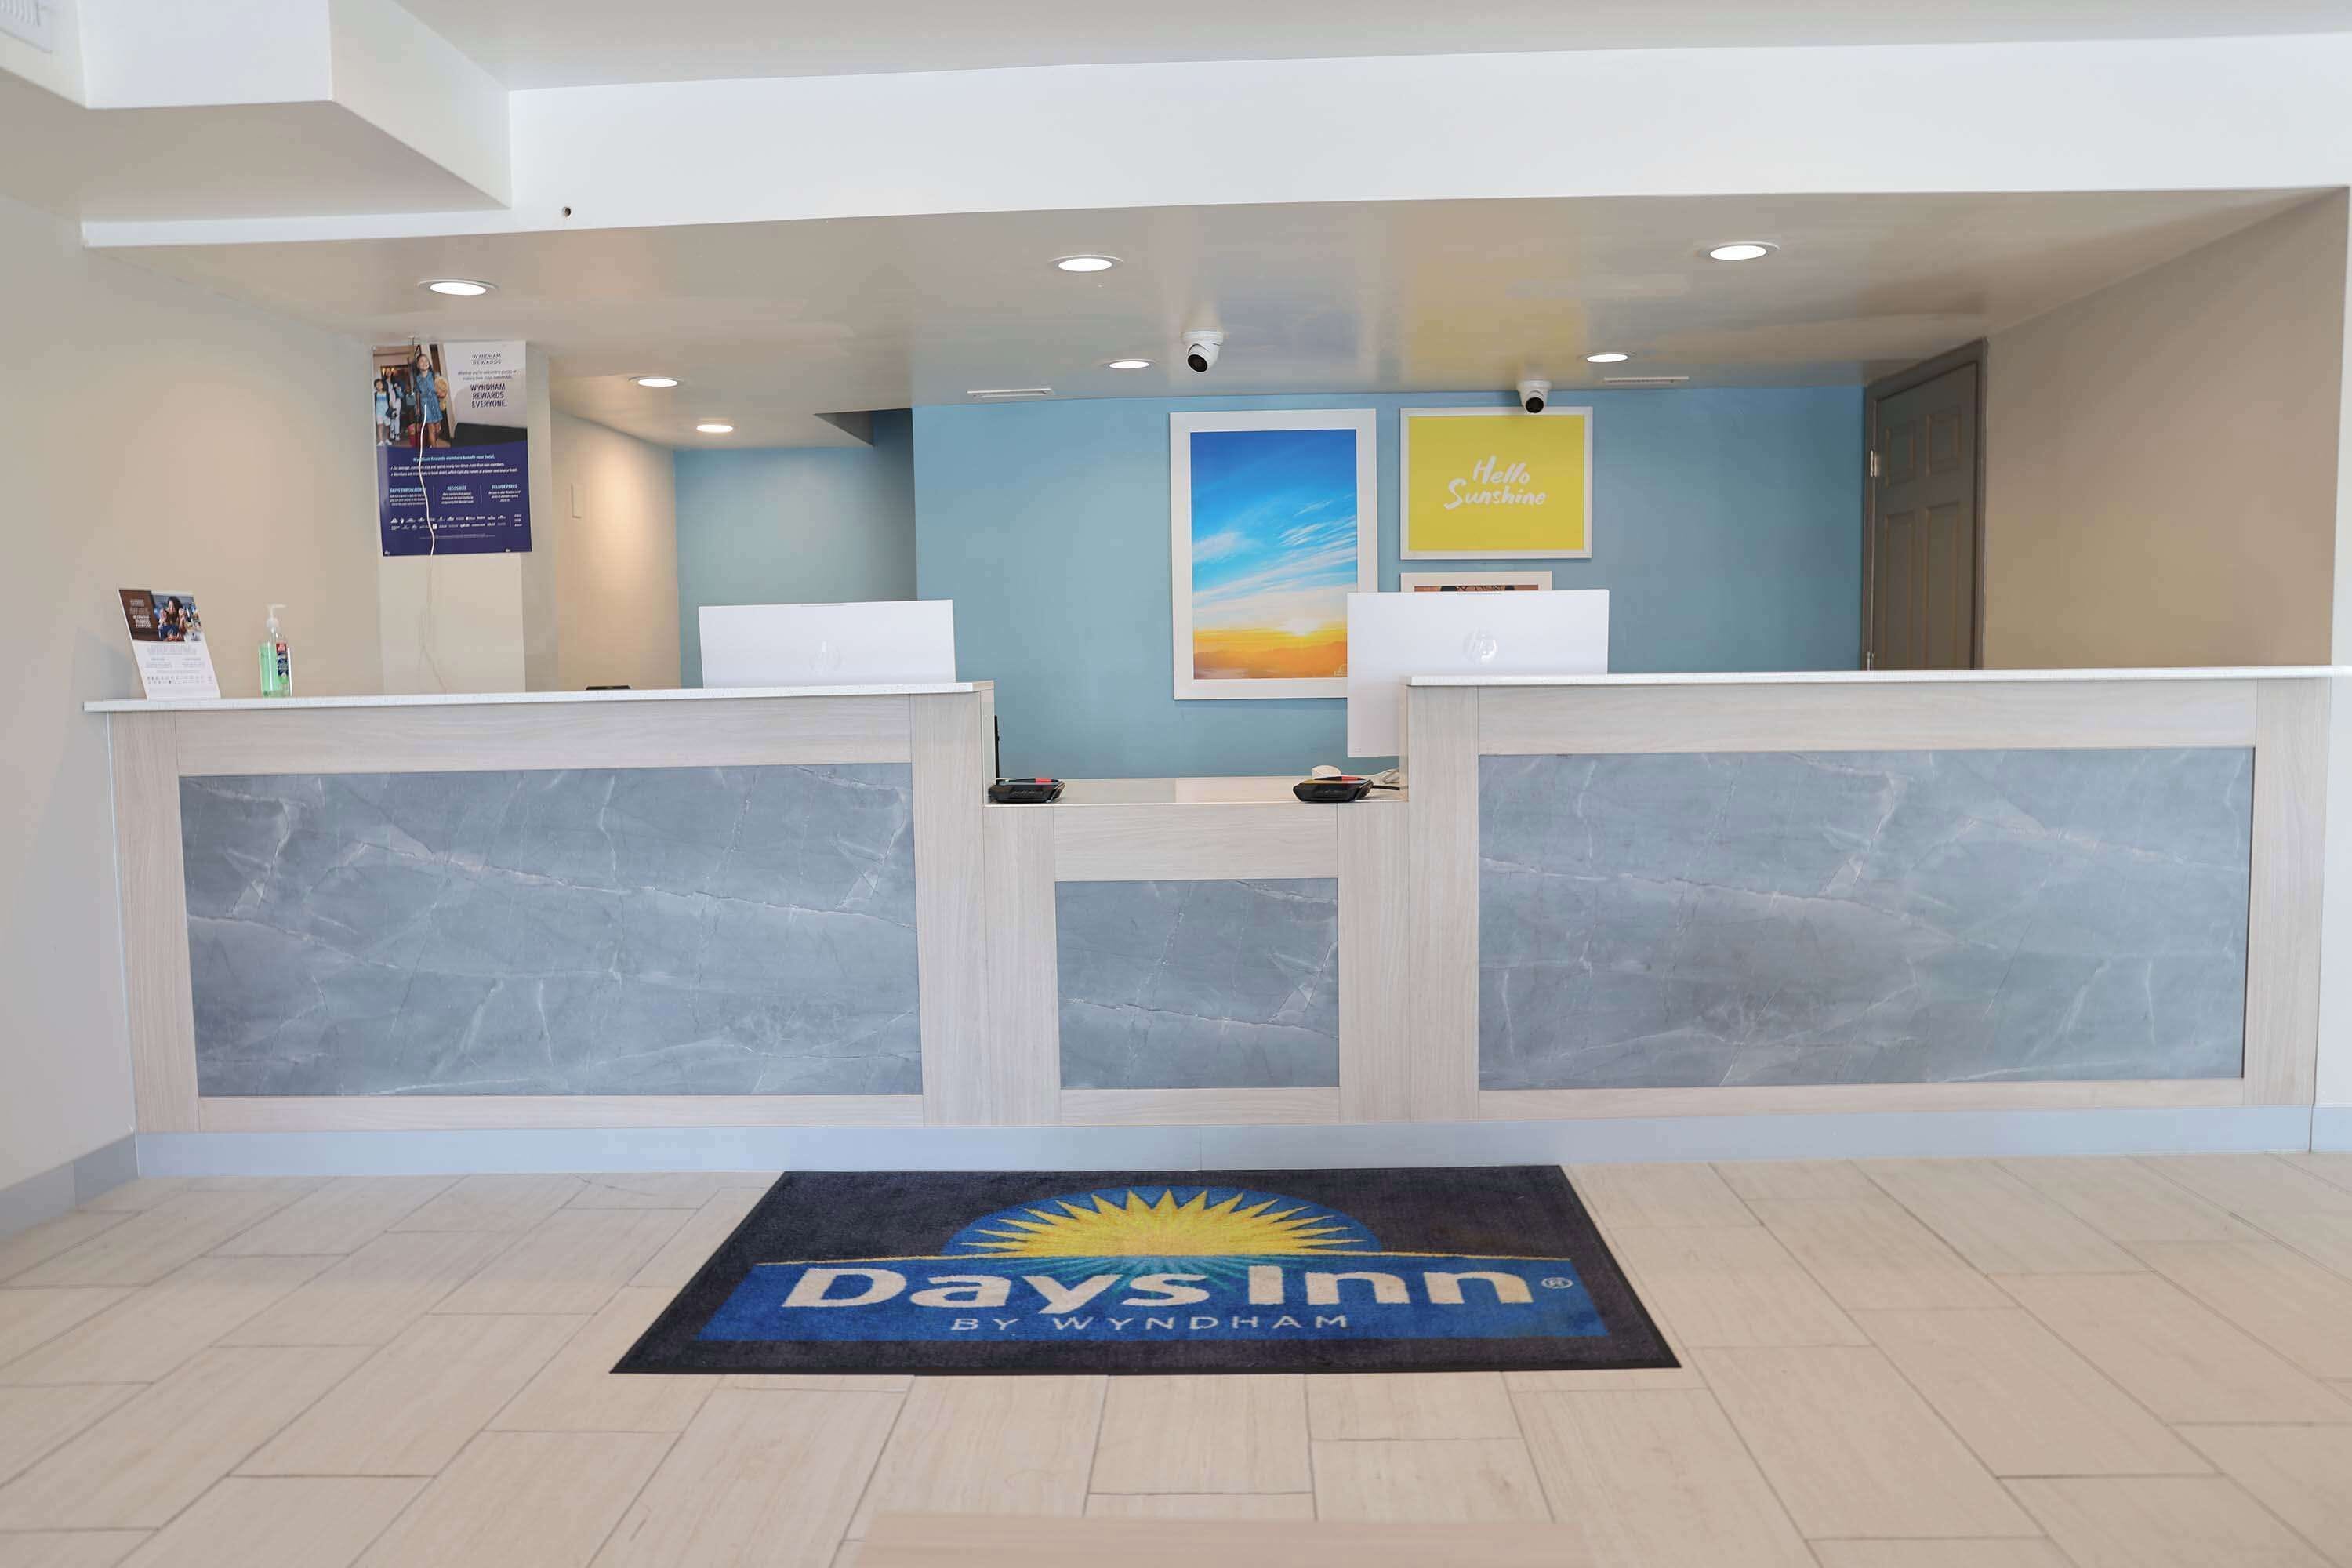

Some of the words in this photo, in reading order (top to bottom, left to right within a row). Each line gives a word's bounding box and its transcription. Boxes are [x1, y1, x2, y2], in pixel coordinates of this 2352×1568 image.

[1472, 456, 1530, 485] Hello
[1443, 478, 1547, 510] Sunshine
[782, 1267, 1210, 1315] Days
[1248, 1265, 1535, 1305] Inn
[951, 1317, 1020, 1331] BY
[1051, 1315, 1348, 1331] WYNDHAM
